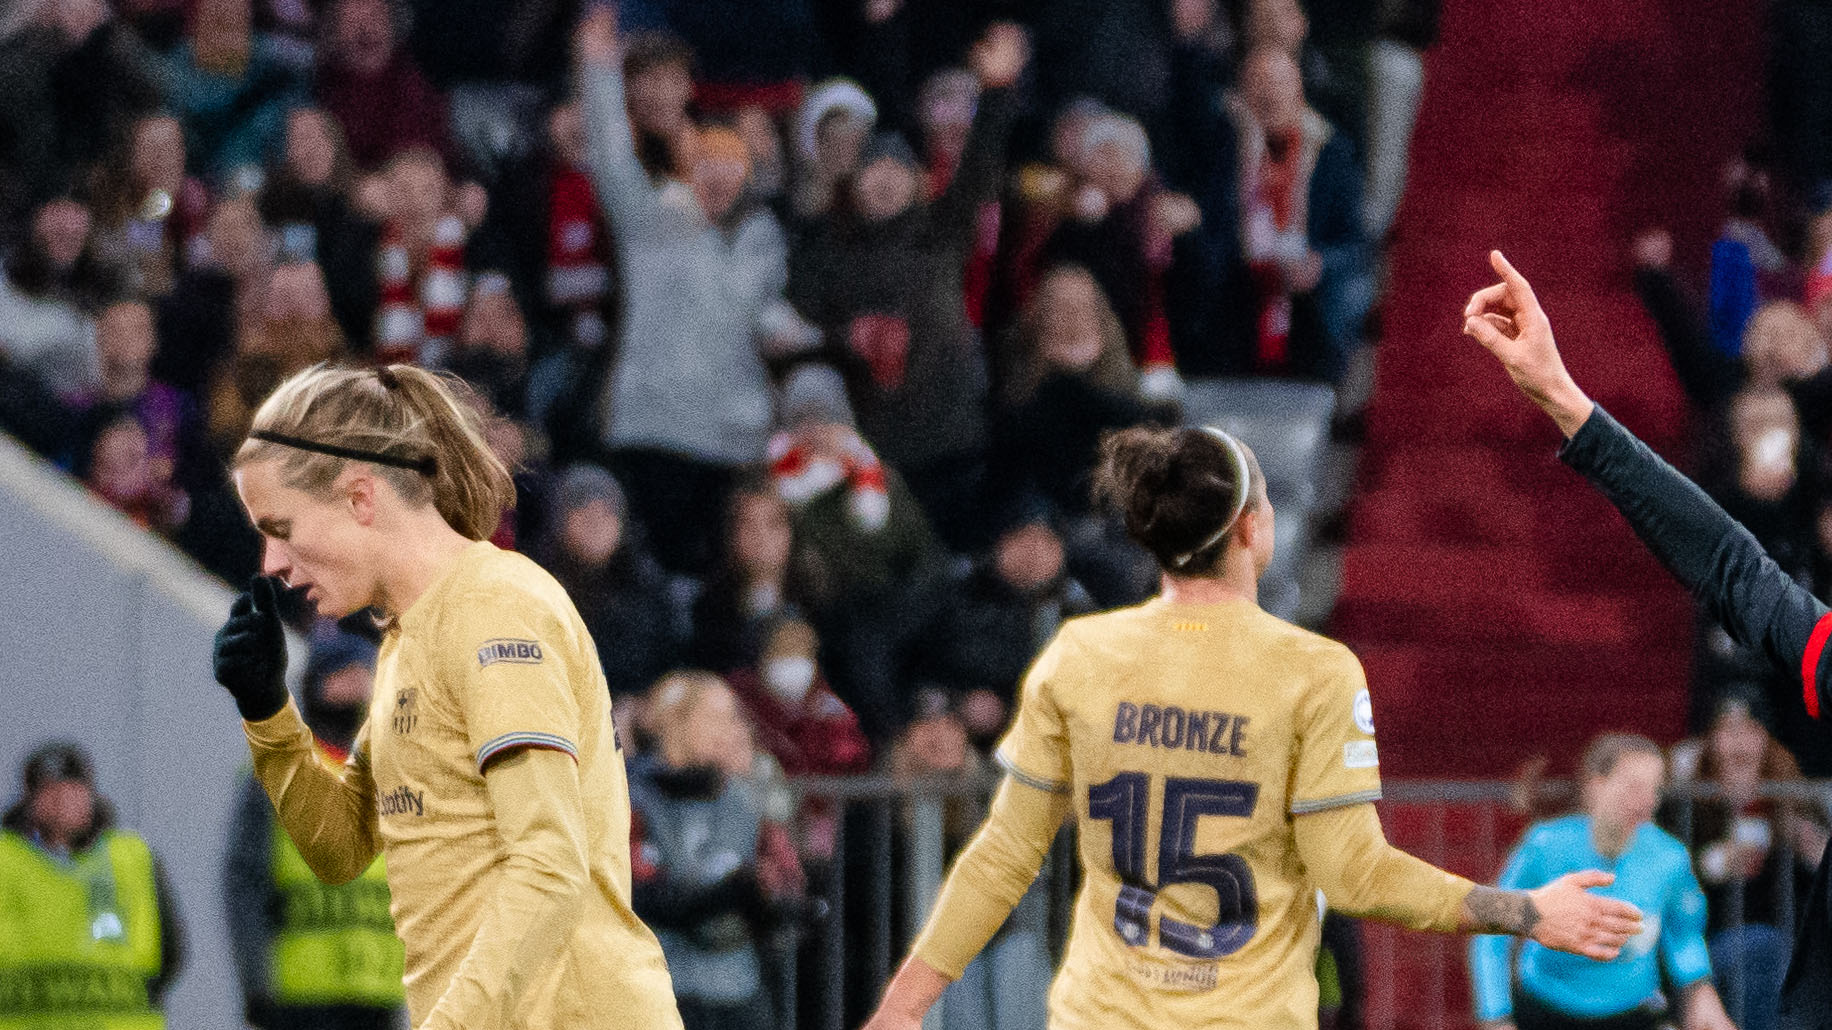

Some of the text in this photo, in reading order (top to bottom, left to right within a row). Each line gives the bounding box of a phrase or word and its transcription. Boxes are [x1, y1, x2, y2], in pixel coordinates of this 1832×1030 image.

[478, 643, 544, 664] BIMBO
[1113, 702, 1251, 757] BRONZE
[376, 786, 424, 816] otify
[1088, 770, 1261, 959] 15
